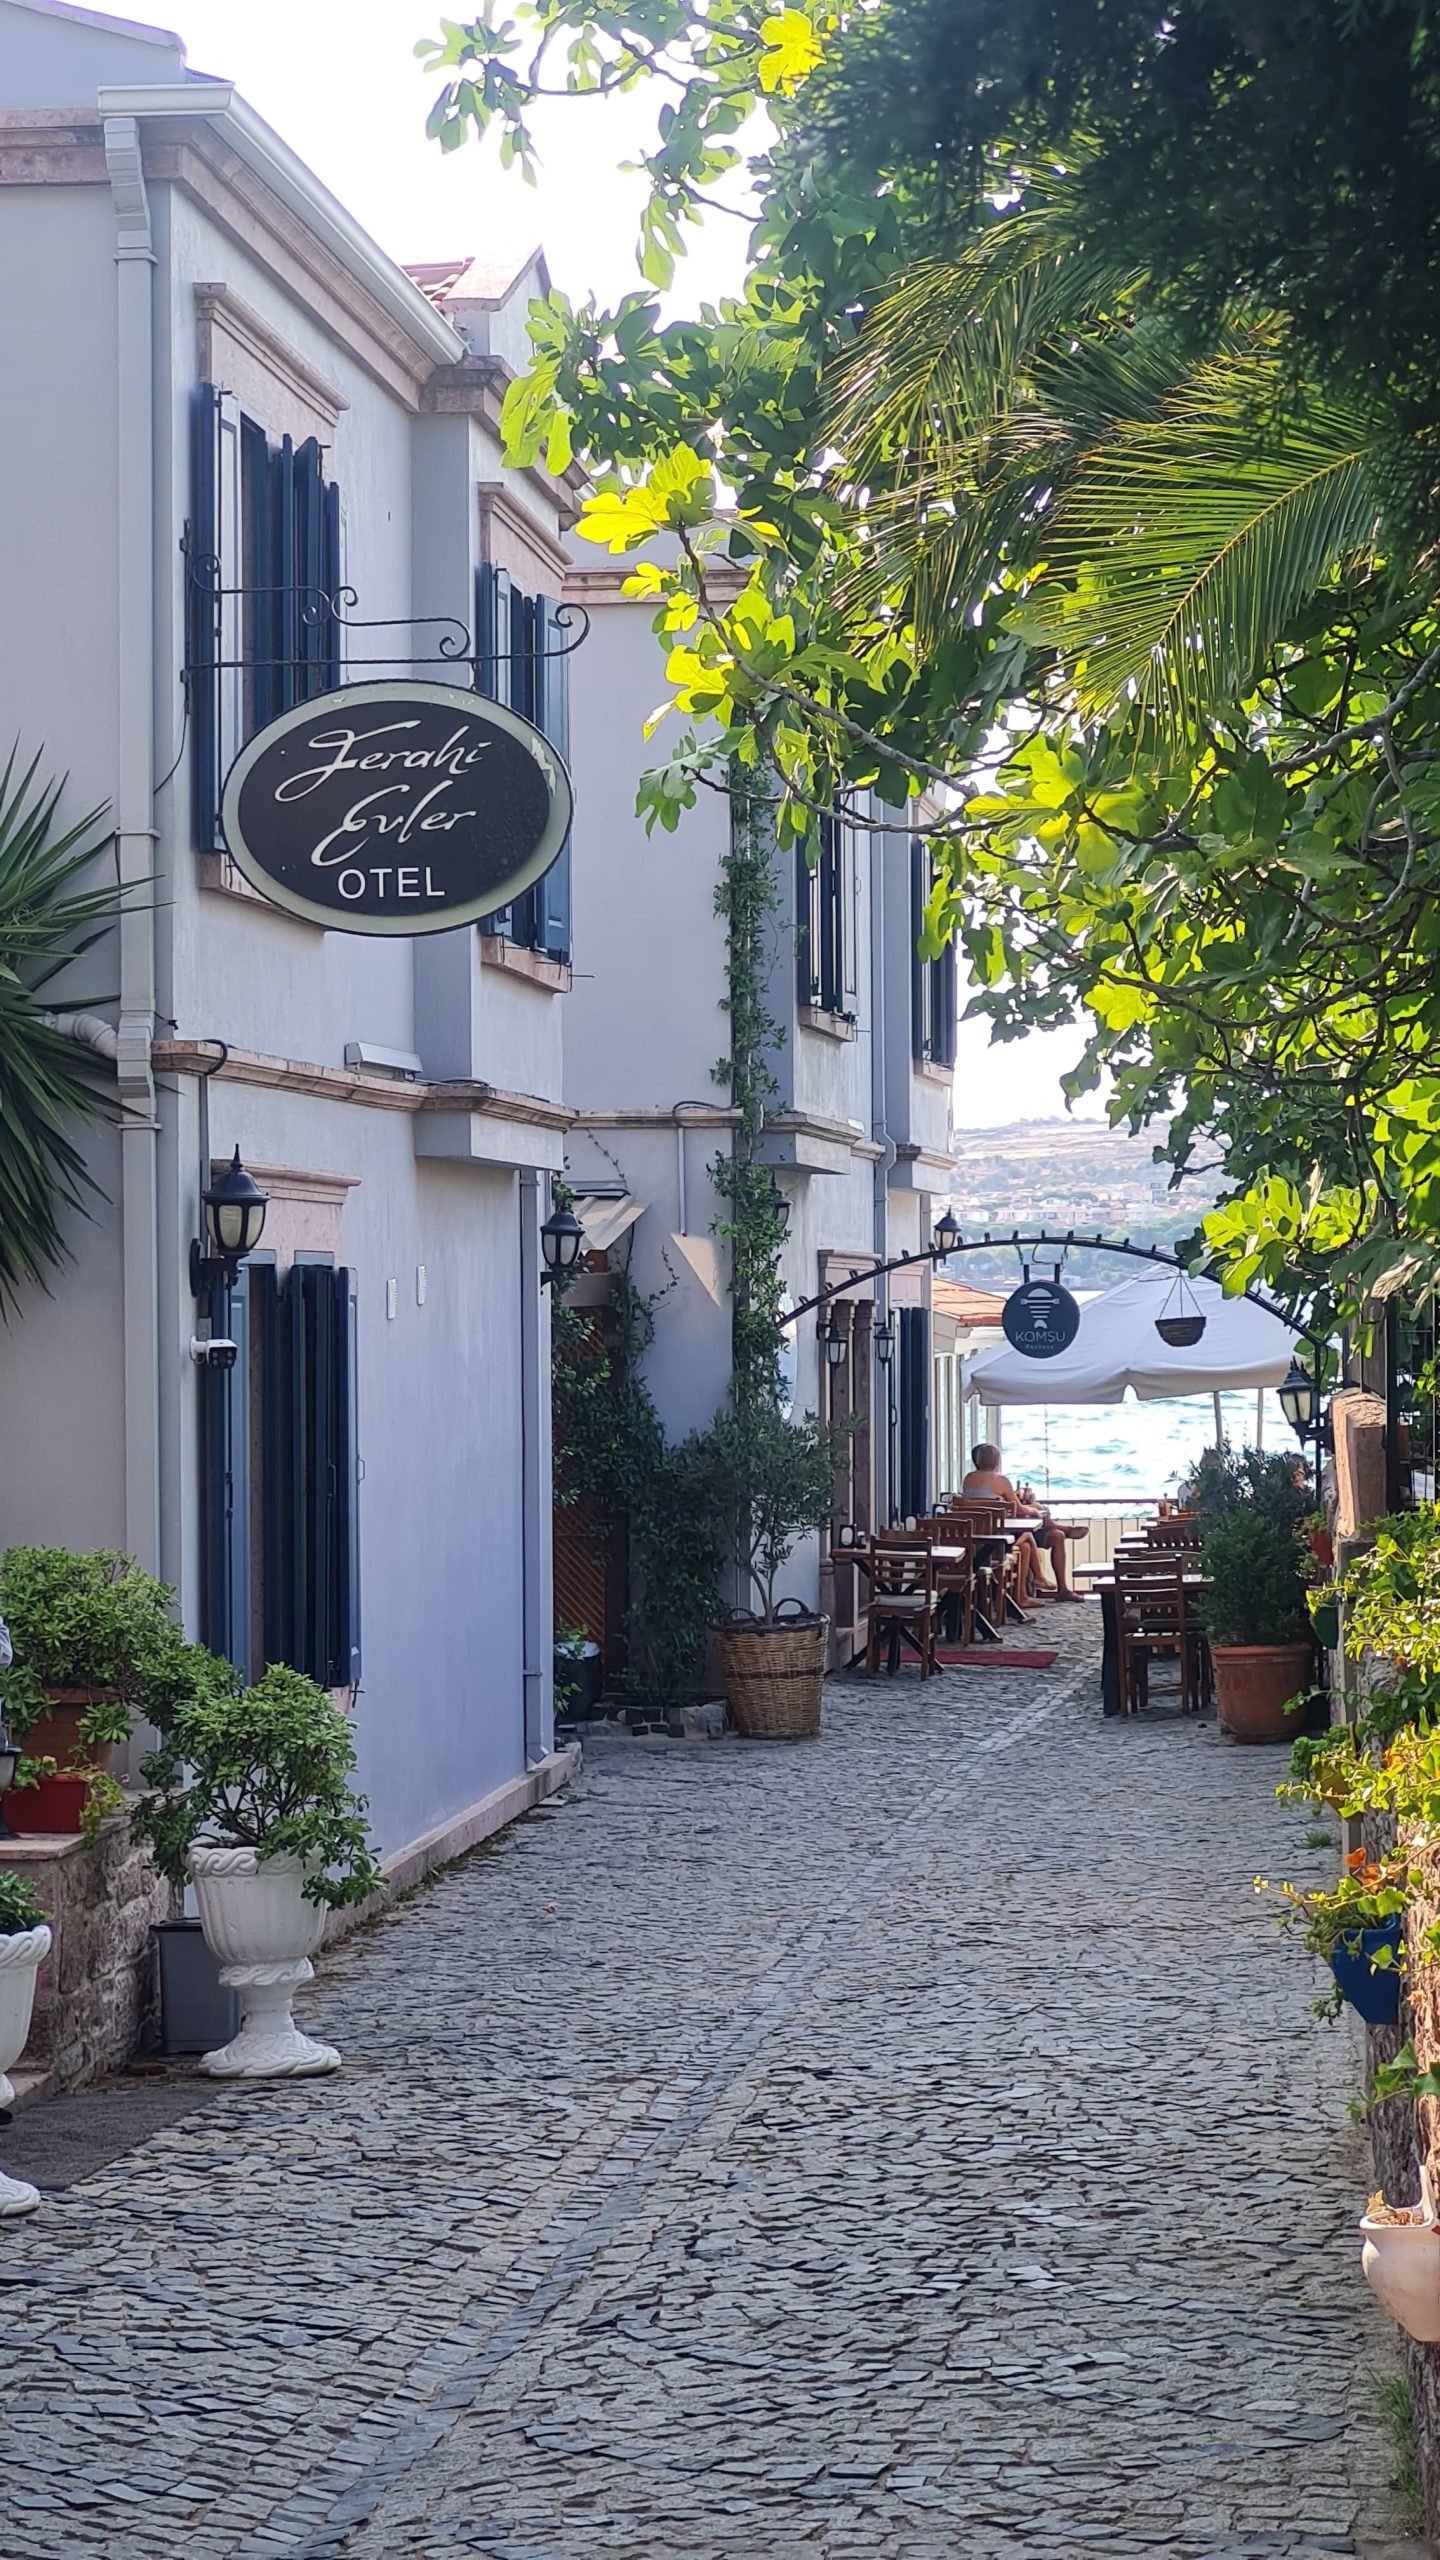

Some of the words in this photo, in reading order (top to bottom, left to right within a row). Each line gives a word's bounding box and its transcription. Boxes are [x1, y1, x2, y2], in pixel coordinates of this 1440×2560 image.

[275, 720, 492, 802] Ferahi
[311, 780, 477, 867] Evler
[337, 866, 446, 899] OTEL
[1015, 1330, 1066, 1343] KOMŞU
